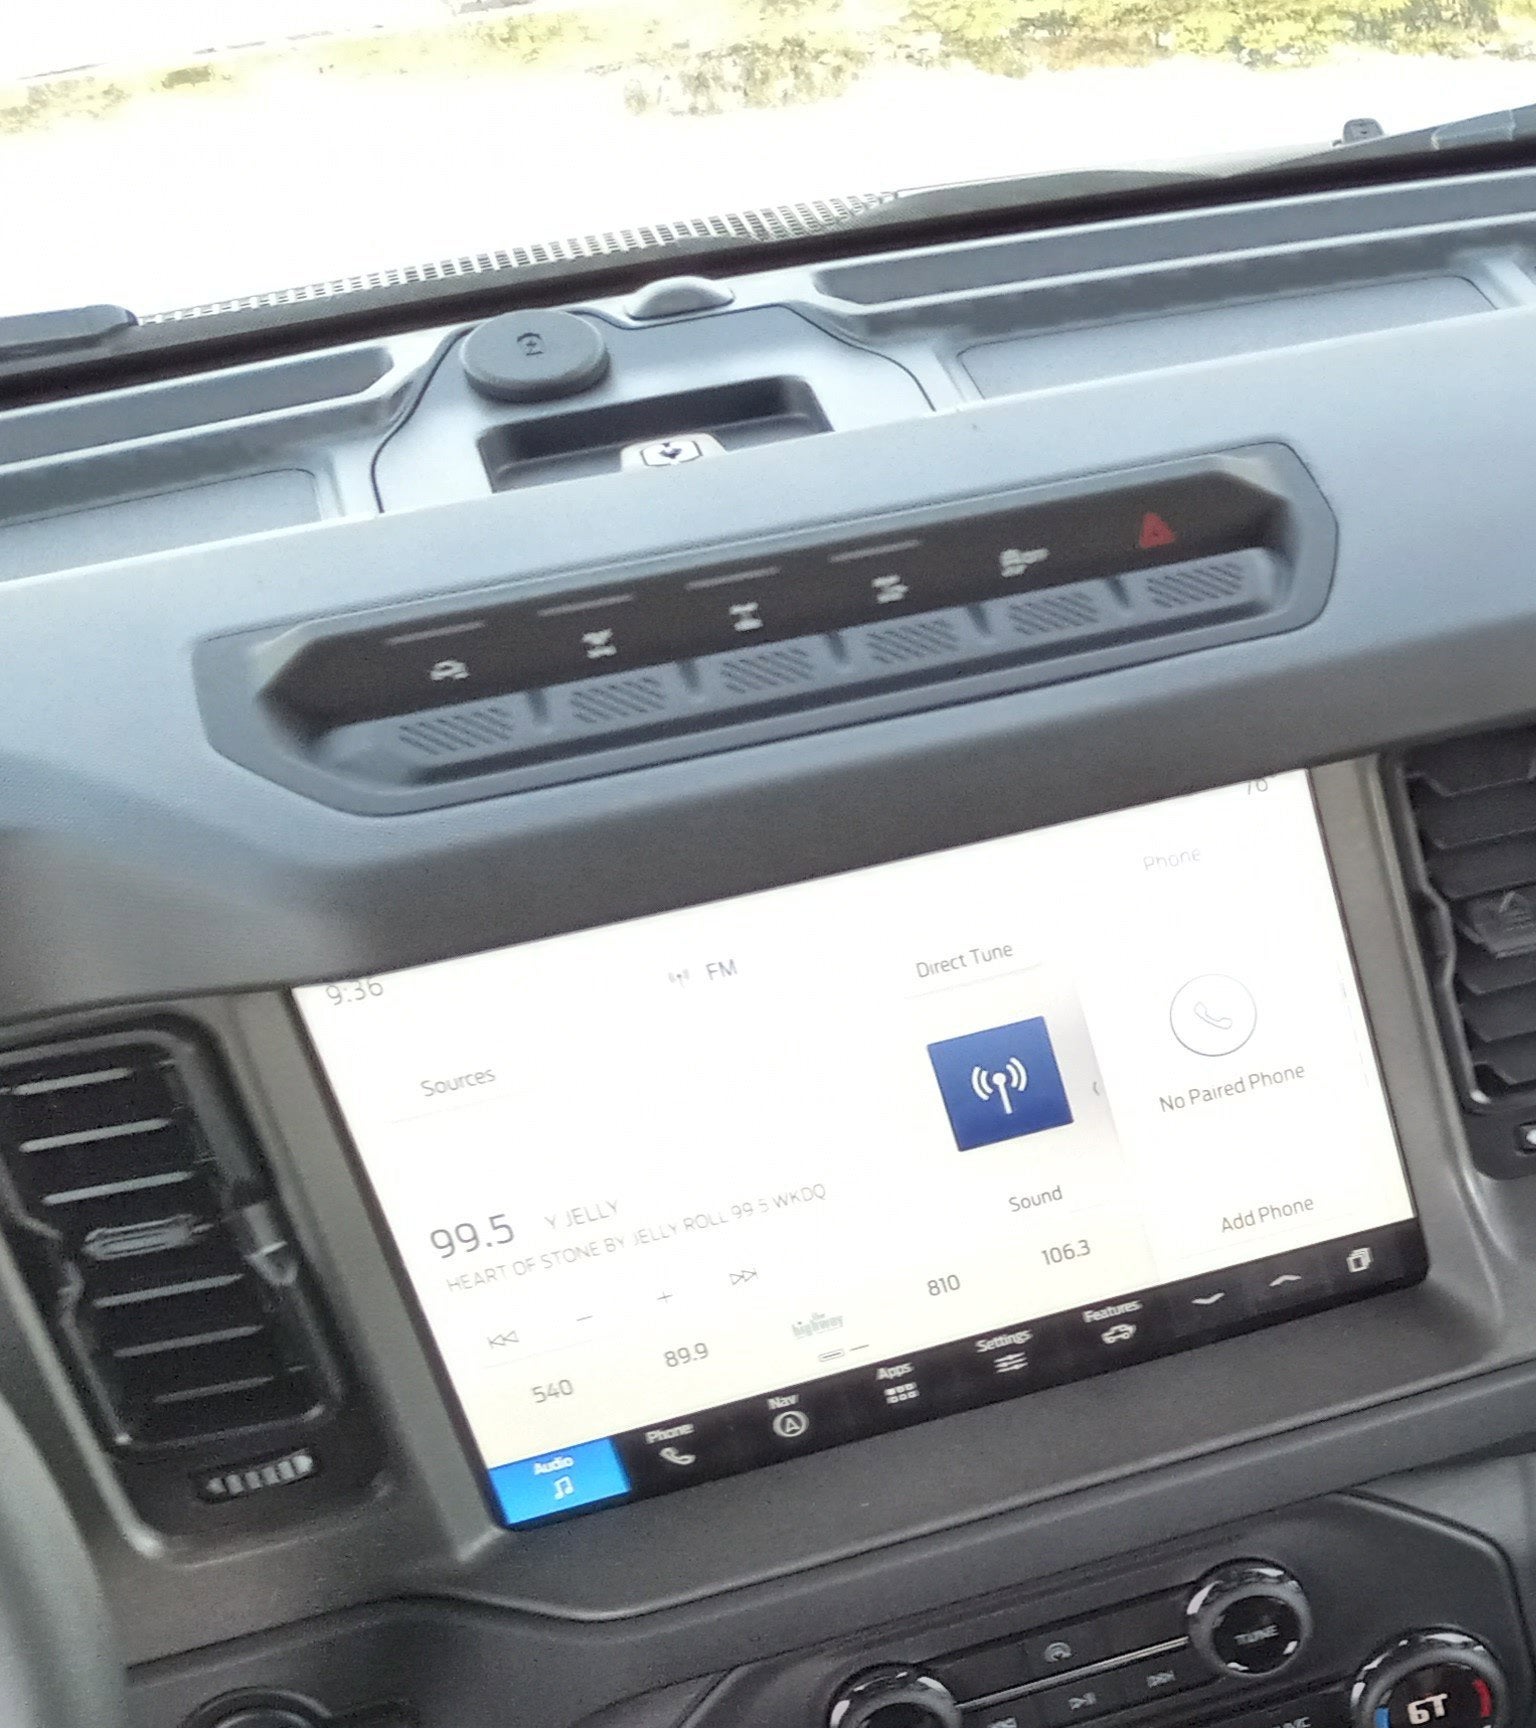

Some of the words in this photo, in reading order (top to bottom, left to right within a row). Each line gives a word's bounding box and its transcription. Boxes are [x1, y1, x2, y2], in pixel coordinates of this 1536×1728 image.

[706, 959, 737, 981] FM
[915, 954, 966, 979] Direct
[970, 943, 1013, 968] Tune
[420, 1068, 496, 1098] Sources
[1159, 1092, 1184, 1113] No
[1188, 1076, 1246, 1106] Paired
[1249, 1064, 1305, 1094] Phone
[1008, 1185, 1063, 1213] Sound
[1221, 1211, 1256, 1233] Add
[1259, 1196, 1314, 1223] Phone
[430, 1214, 515, 1259] 99.5
[566, 1199, 619, 1228] JELLY
[447, 1264, 507, 1292] HEART
[513, 1257, 536, 1276] OF
[541, 1242, 601, 1270] STONE
[605, 1235, 626, 1253] BY
[633, 1223, 679, 1246] JELLY
[684, 1209, 729, 1232] ROLL
[774, 1184, 827, 1209] WKDQ
[1042, 1239, 1092, 1266] 106.3
[927, 1274, 961, 1297] 810
[1083, 1300, 1142, 1323] Features
[976, 1330, 1033, 1353] Settings
[664, 1342, 710, 1368] 89.9
[876, 1363, 914, 1381] Apps
[532, 1378, 575, 1404] 540
[767, 1394, 799, 1410] Nav
[645, 1422, 694, 1444] Phone
[533, 1454, 575, 1477] Audio
[1235, 1624, 1279, 1646] TUNE
